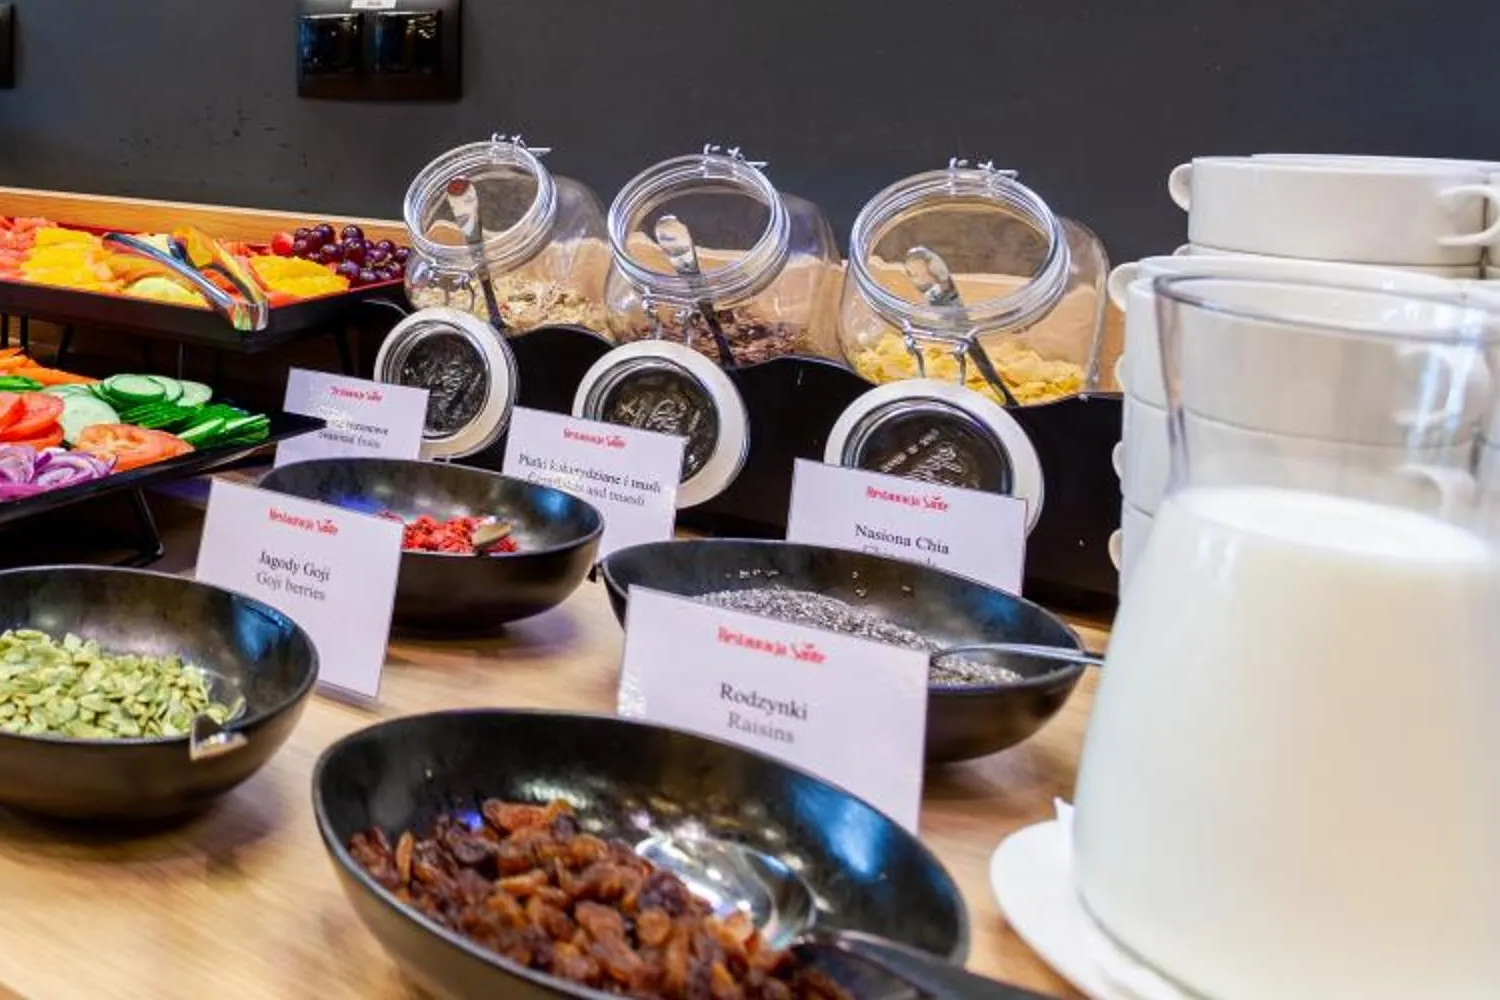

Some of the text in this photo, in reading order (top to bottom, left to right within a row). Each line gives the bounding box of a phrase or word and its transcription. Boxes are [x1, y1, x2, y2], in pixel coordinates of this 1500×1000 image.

[855, 523, 950, 555] Nasiona Chia
[259, 550, 331, 582] Jagody Goji
[256, 571, 327, 601] Goji berries
[719, 681, 809, 721] Rodzynki
[727, 711, 796, 745] Raisins
